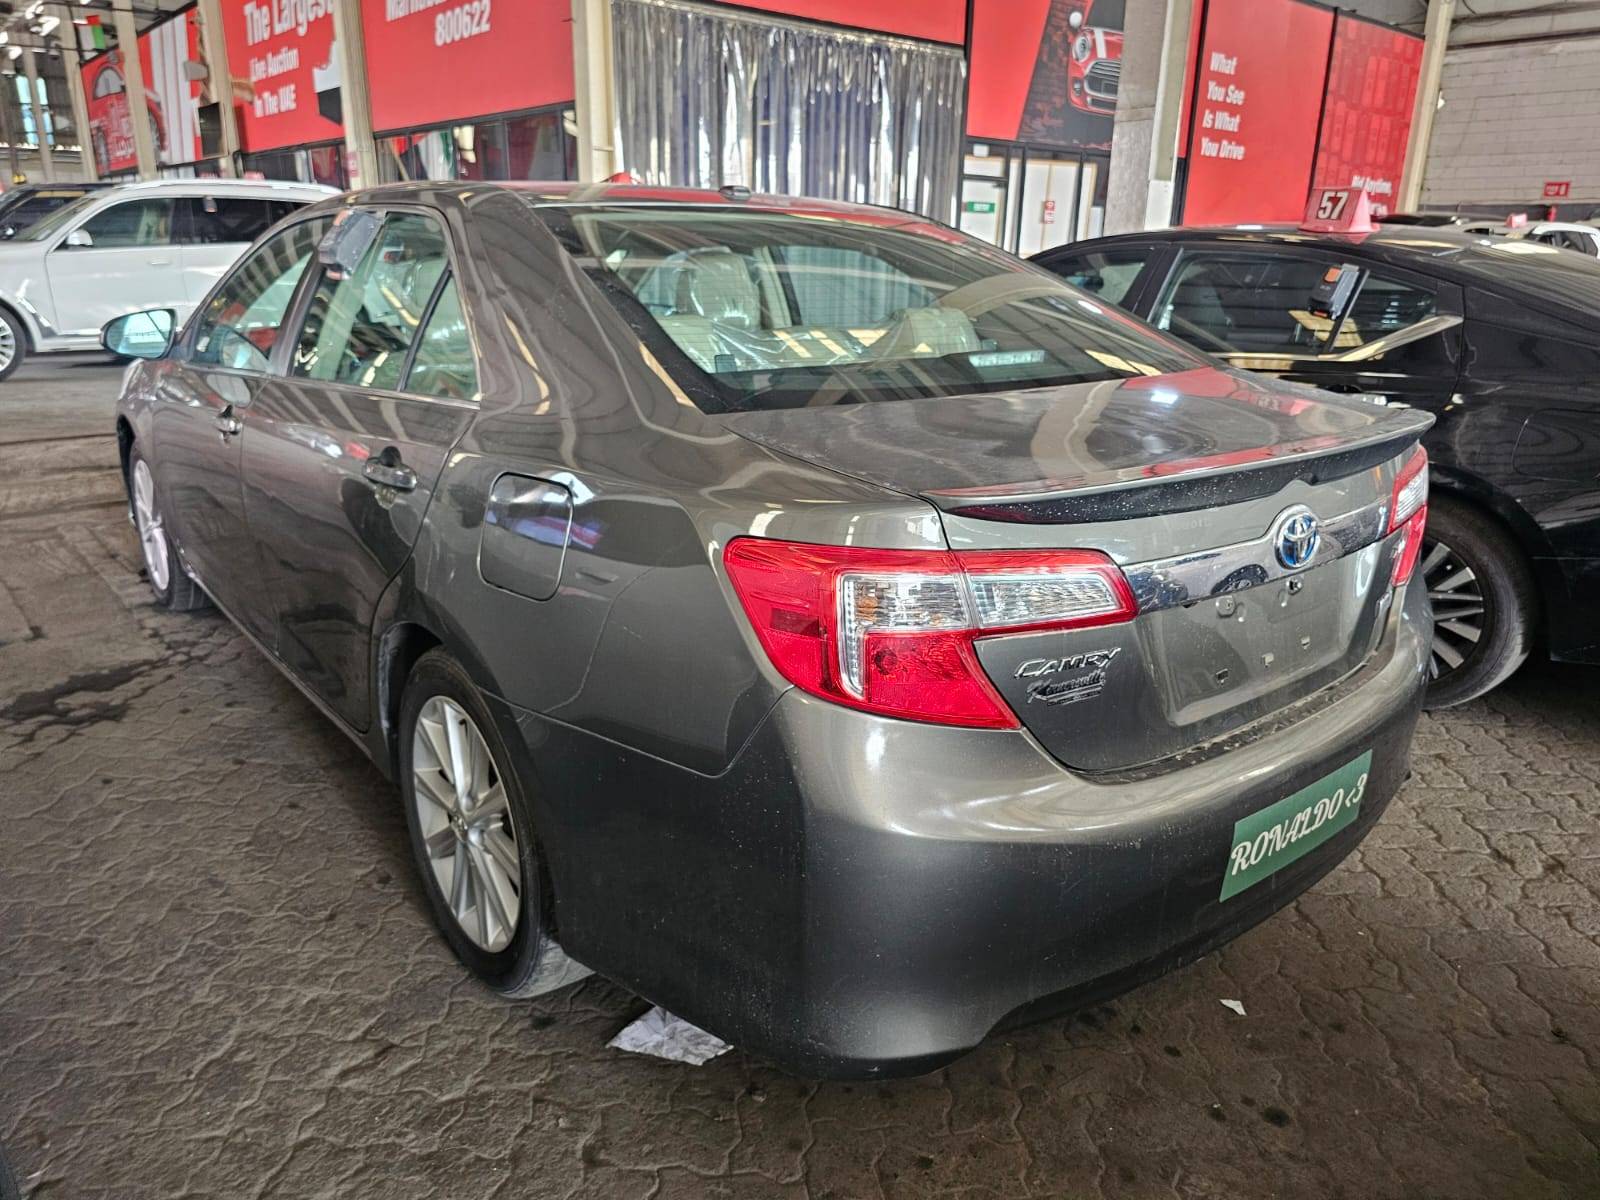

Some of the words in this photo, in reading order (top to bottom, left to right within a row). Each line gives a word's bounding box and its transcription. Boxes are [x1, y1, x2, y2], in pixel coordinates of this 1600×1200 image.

[243, 1, 271, 46] The
[435, 0, 491, 46] 800622
[266, 46, 299, 78] Auction
[1210, 51, 1238, 75] What
[262, 90, 279, 115] The
[278, 83, 297, 112] UAE
[1207, 79, 1227, 102] You
[1226, 84, 1246, 106] See
[1202, 109, 1214, 128] Is
[1214, 110, 1241, 133] What
[1200, 137, 1220, 158] You
[1219, 139, 1246, 161] Drive
[1317, 191, 1349, 220] 57
[1014, 647, 1121, 679] CAMRY
[1231, 788, 1344, 876] RONALDO
